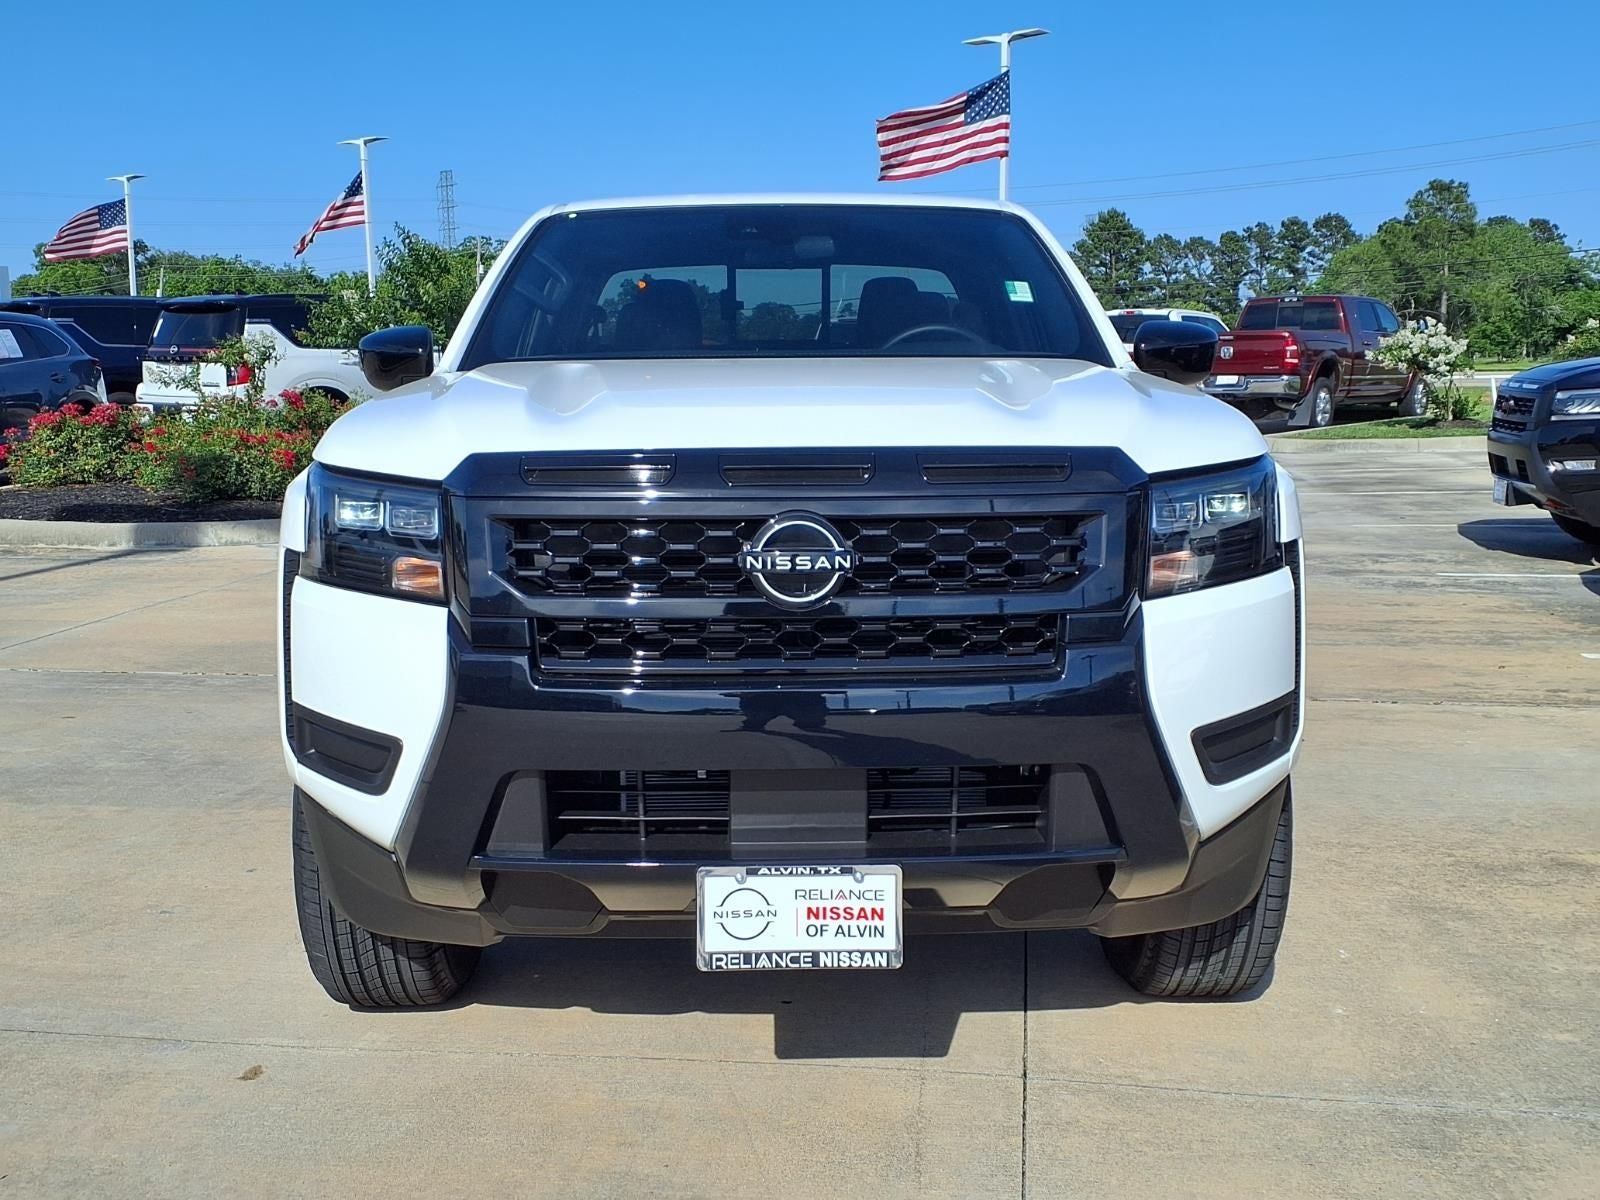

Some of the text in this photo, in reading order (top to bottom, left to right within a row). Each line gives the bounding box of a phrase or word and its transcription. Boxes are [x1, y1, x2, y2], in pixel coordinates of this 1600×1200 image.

[746, 555, 850, 569] NISSAN
[817, 867, 841, 875] TX
[795, 889, 885, 901] RELIANCE
[713, 909, 777, 919] NISSAN
[806, 907, 884, 921] NISSAN
[806, 924, 884, 938] OF ALVIN
[712, 952, 888, 969] RELIANCE NISSAN
